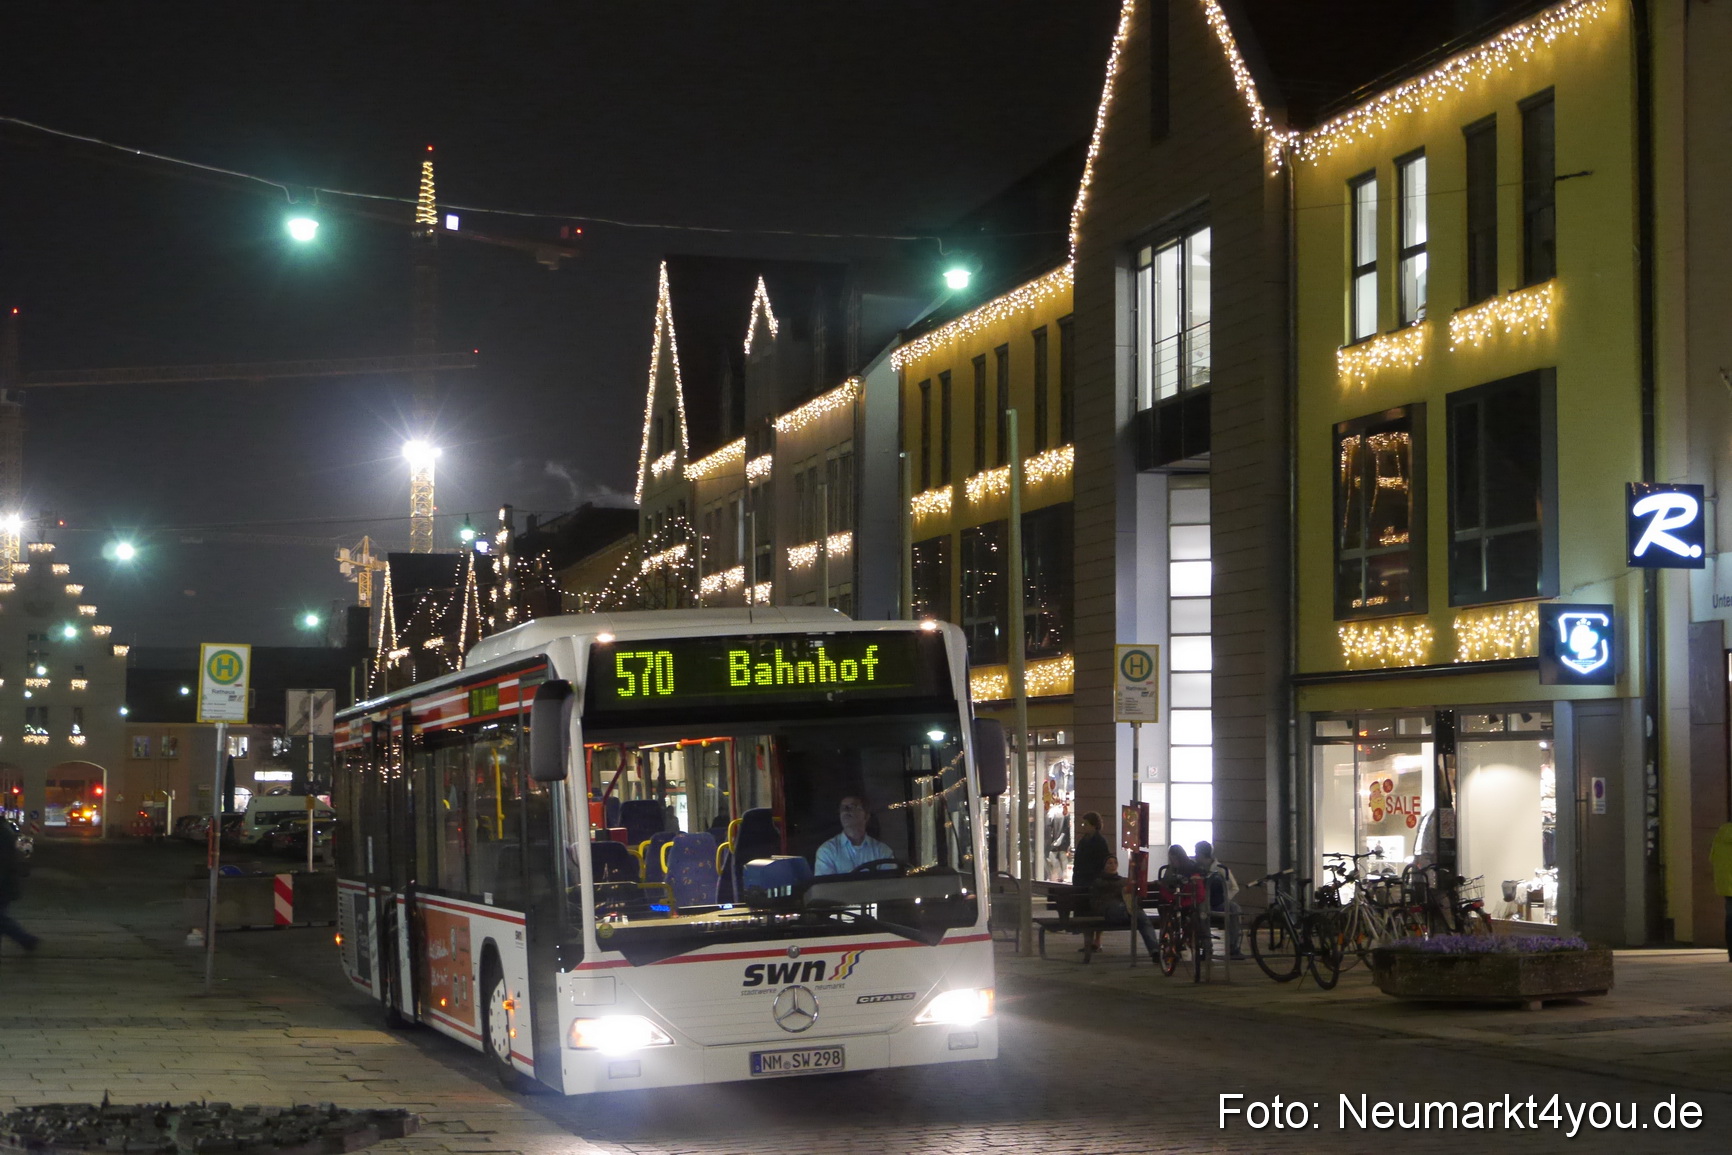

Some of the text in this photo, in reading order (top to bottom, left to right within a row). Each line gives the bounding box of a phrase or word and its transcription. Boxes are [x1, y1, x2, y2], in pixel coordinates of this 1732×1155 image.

[216, 657, 234, 677] H
[616, 644, 879, 697] 570 Bahnhof
[1130, 657, 1144, 675] H
[1385, 795, 1421, 815] SALE
[742, 960, 827, 987] swn
[740, 983, 846, 997] stadtwerke neumarkt
[858, 993, 914, 1003] CITARO
[762, 1050, 841, 1071] NM SW 298
